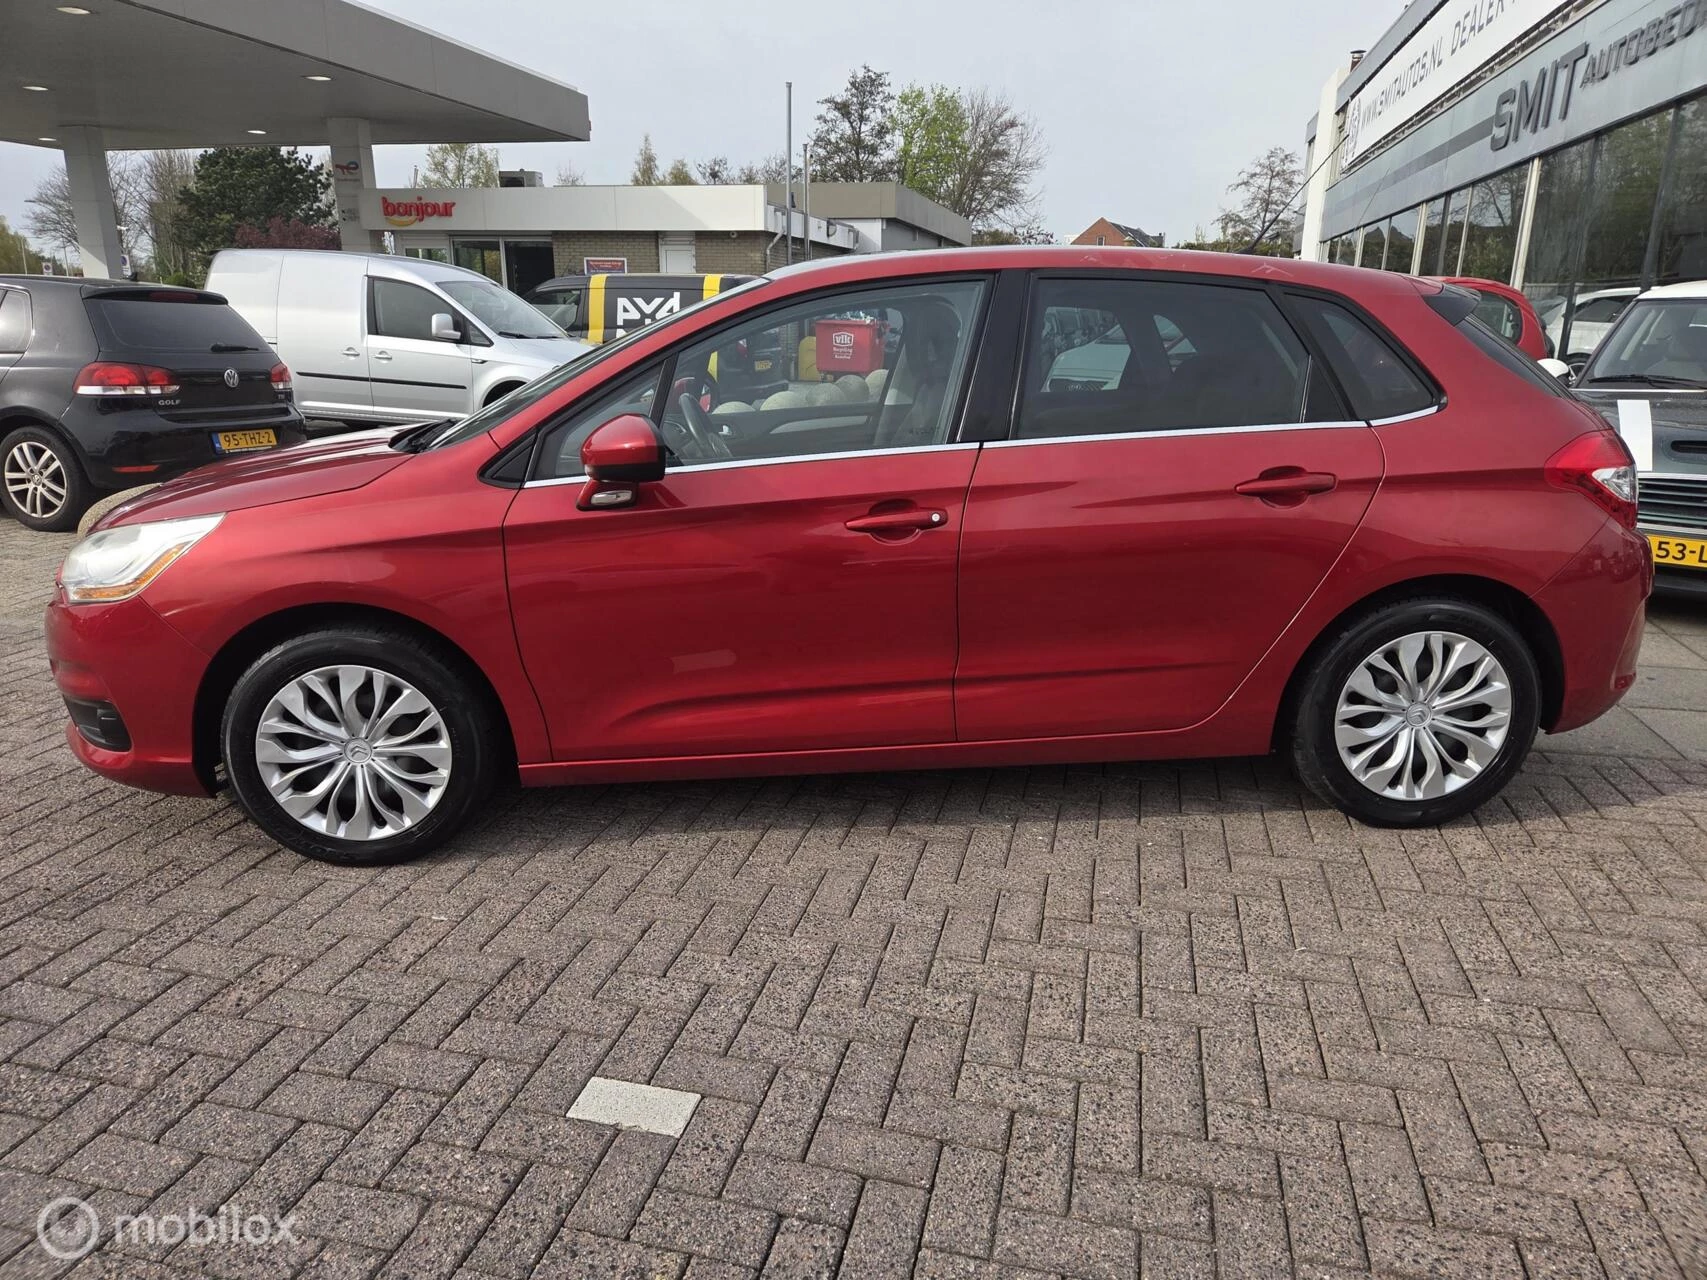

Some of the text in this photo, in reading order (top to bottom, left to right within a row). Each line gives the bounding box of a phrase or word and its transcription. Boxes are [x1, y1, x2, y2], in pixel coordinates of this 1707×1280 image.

[1490, 41, 1588, 152] SMIT
[381, 196, 456, 223] bonjour
[223, 431, 273, 447] 95-THZ-2
